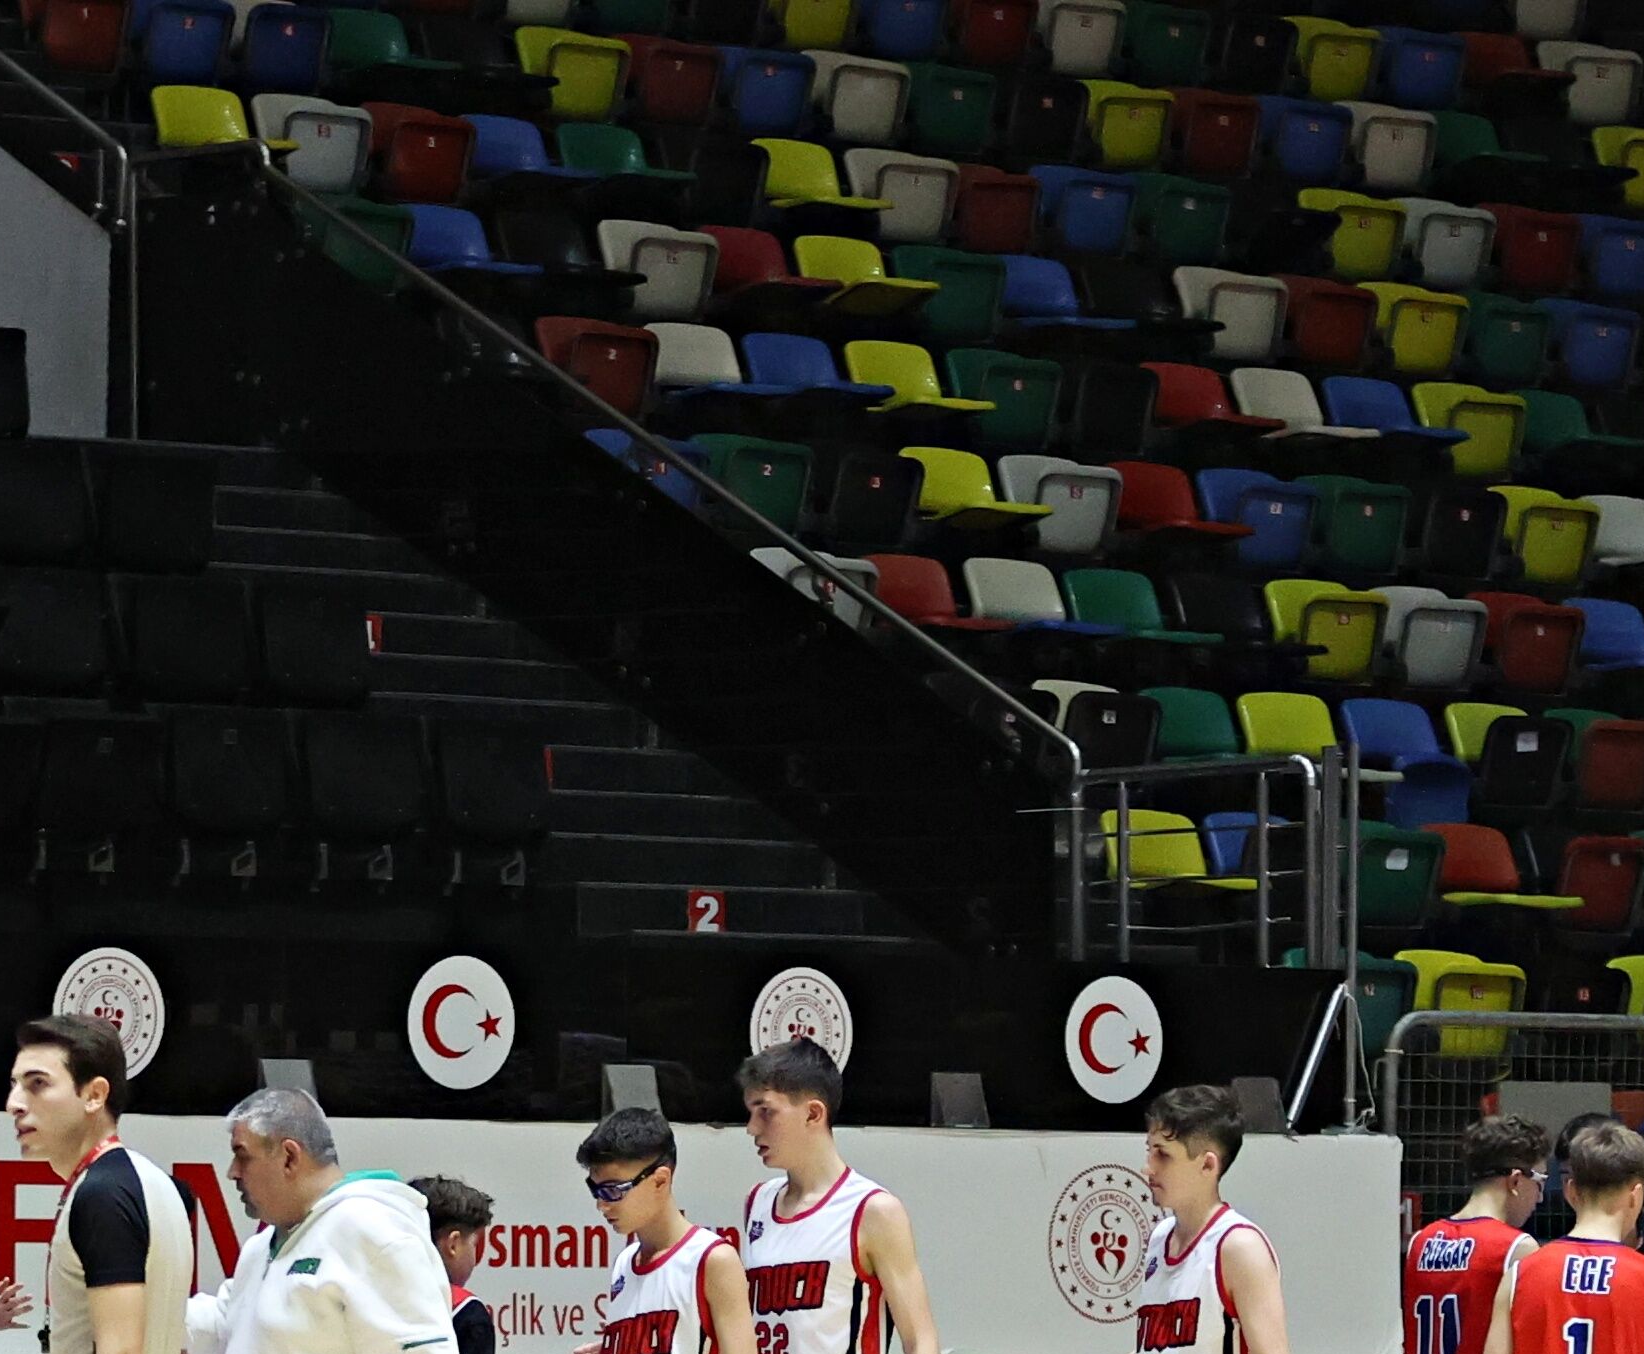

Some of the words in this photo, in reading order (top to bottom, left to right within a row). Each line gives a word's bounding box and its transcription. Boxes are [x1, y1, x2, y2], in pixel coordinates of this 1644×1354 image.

[696, 895, 719, 933] 2
[1562, 1254, 1617, 1295] EGE
[553, 1304, 585, 1336] ve
